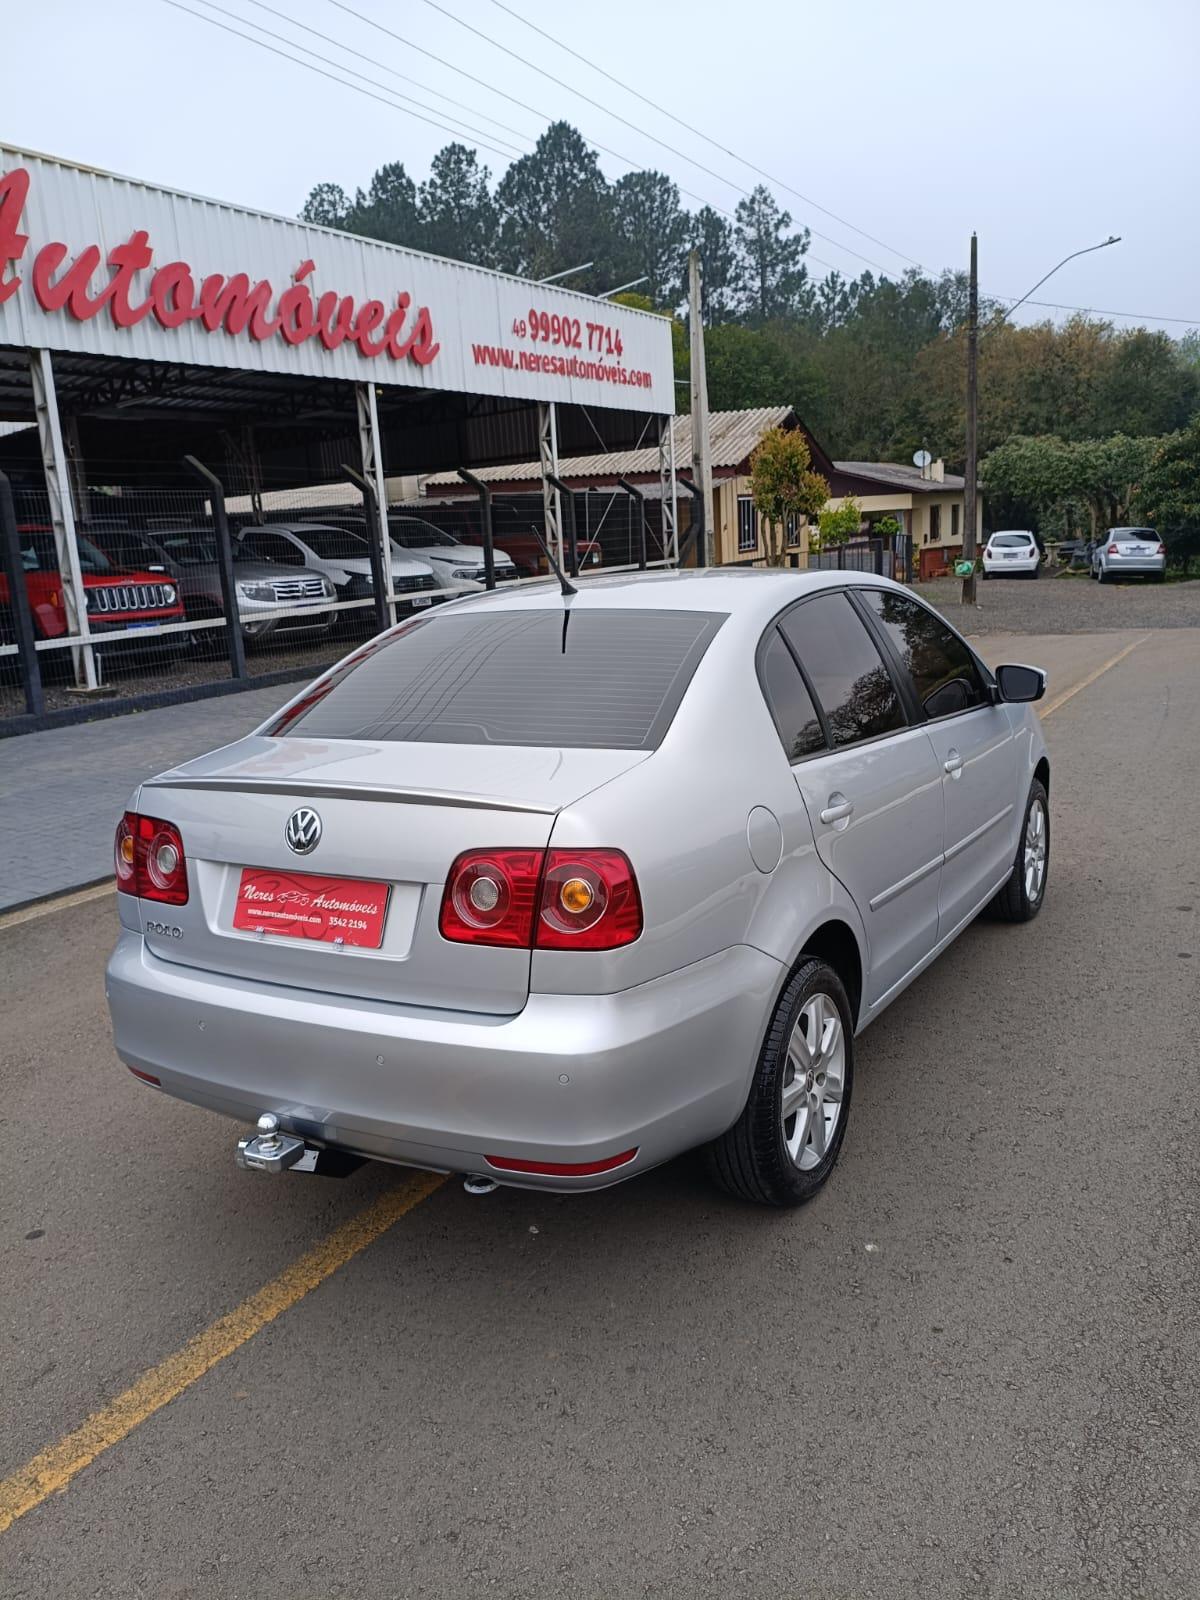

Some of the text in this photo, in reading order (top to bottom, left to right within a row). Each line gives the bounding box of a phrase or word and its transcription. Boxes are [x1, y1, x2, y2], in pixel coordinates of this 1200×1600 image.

[512, 308, 623, 356] 49 99902 7714
[472, 343, 652, 388] www.neresautomóveis.com
[244, 884, 378, 915] Neres Automóveis
[146, 921, 183, 938] POLO
[328, 916, 347, 928] 3542
